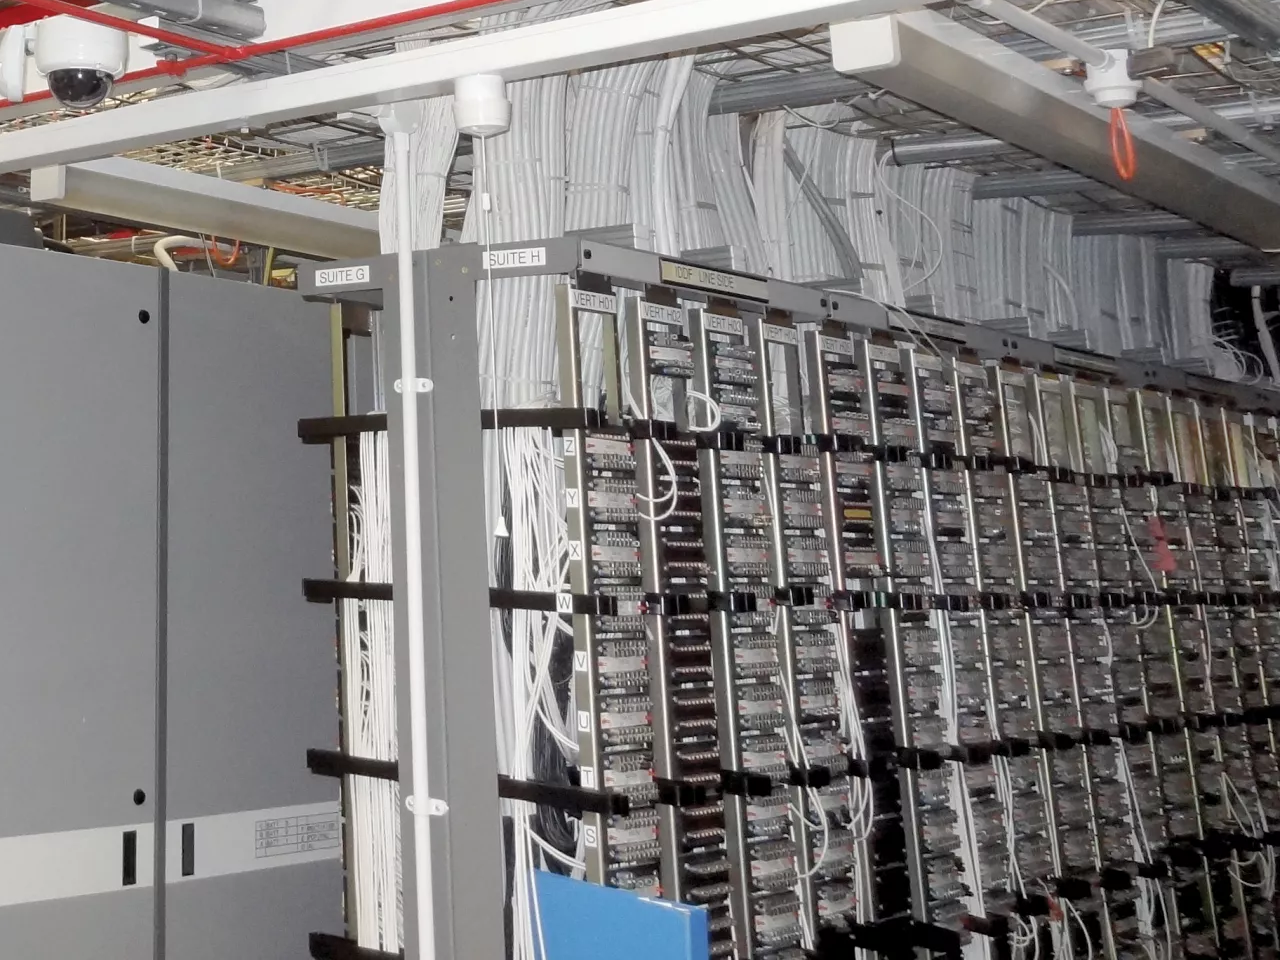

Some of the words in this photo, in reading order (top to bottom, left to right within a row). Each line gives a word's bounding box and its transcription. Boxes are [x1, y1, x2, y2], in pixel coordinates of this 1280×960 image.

[489, 251, 526, 267] SUITE
[531, 250, 540, 263] H
[319, 269, 353, 284] SUITE
[355, 268, 365, 280] G
[699, 270, 716, 285] LINE
[717, 274, 734, 289] SIDE
[573, 292, 597, 307] VERT
[599, 297, 613, 310] H01
[644, 304, 665, 318] VERT
[667, 308, 681, 322] H02
[707, 315, 726, 330] VERT
[728, 319, 741, 332] H03
[566, 440, 574, 453] Z
[568, 491, 577, 505] Y
[571, 543, 580, 557] X
[558, 596, 571, 611] W
[576, 653, 586, 668] V
[579, 714, 589, 729] U
[583, 769, 592, 785] T
[586, 828, 595, 844] S
